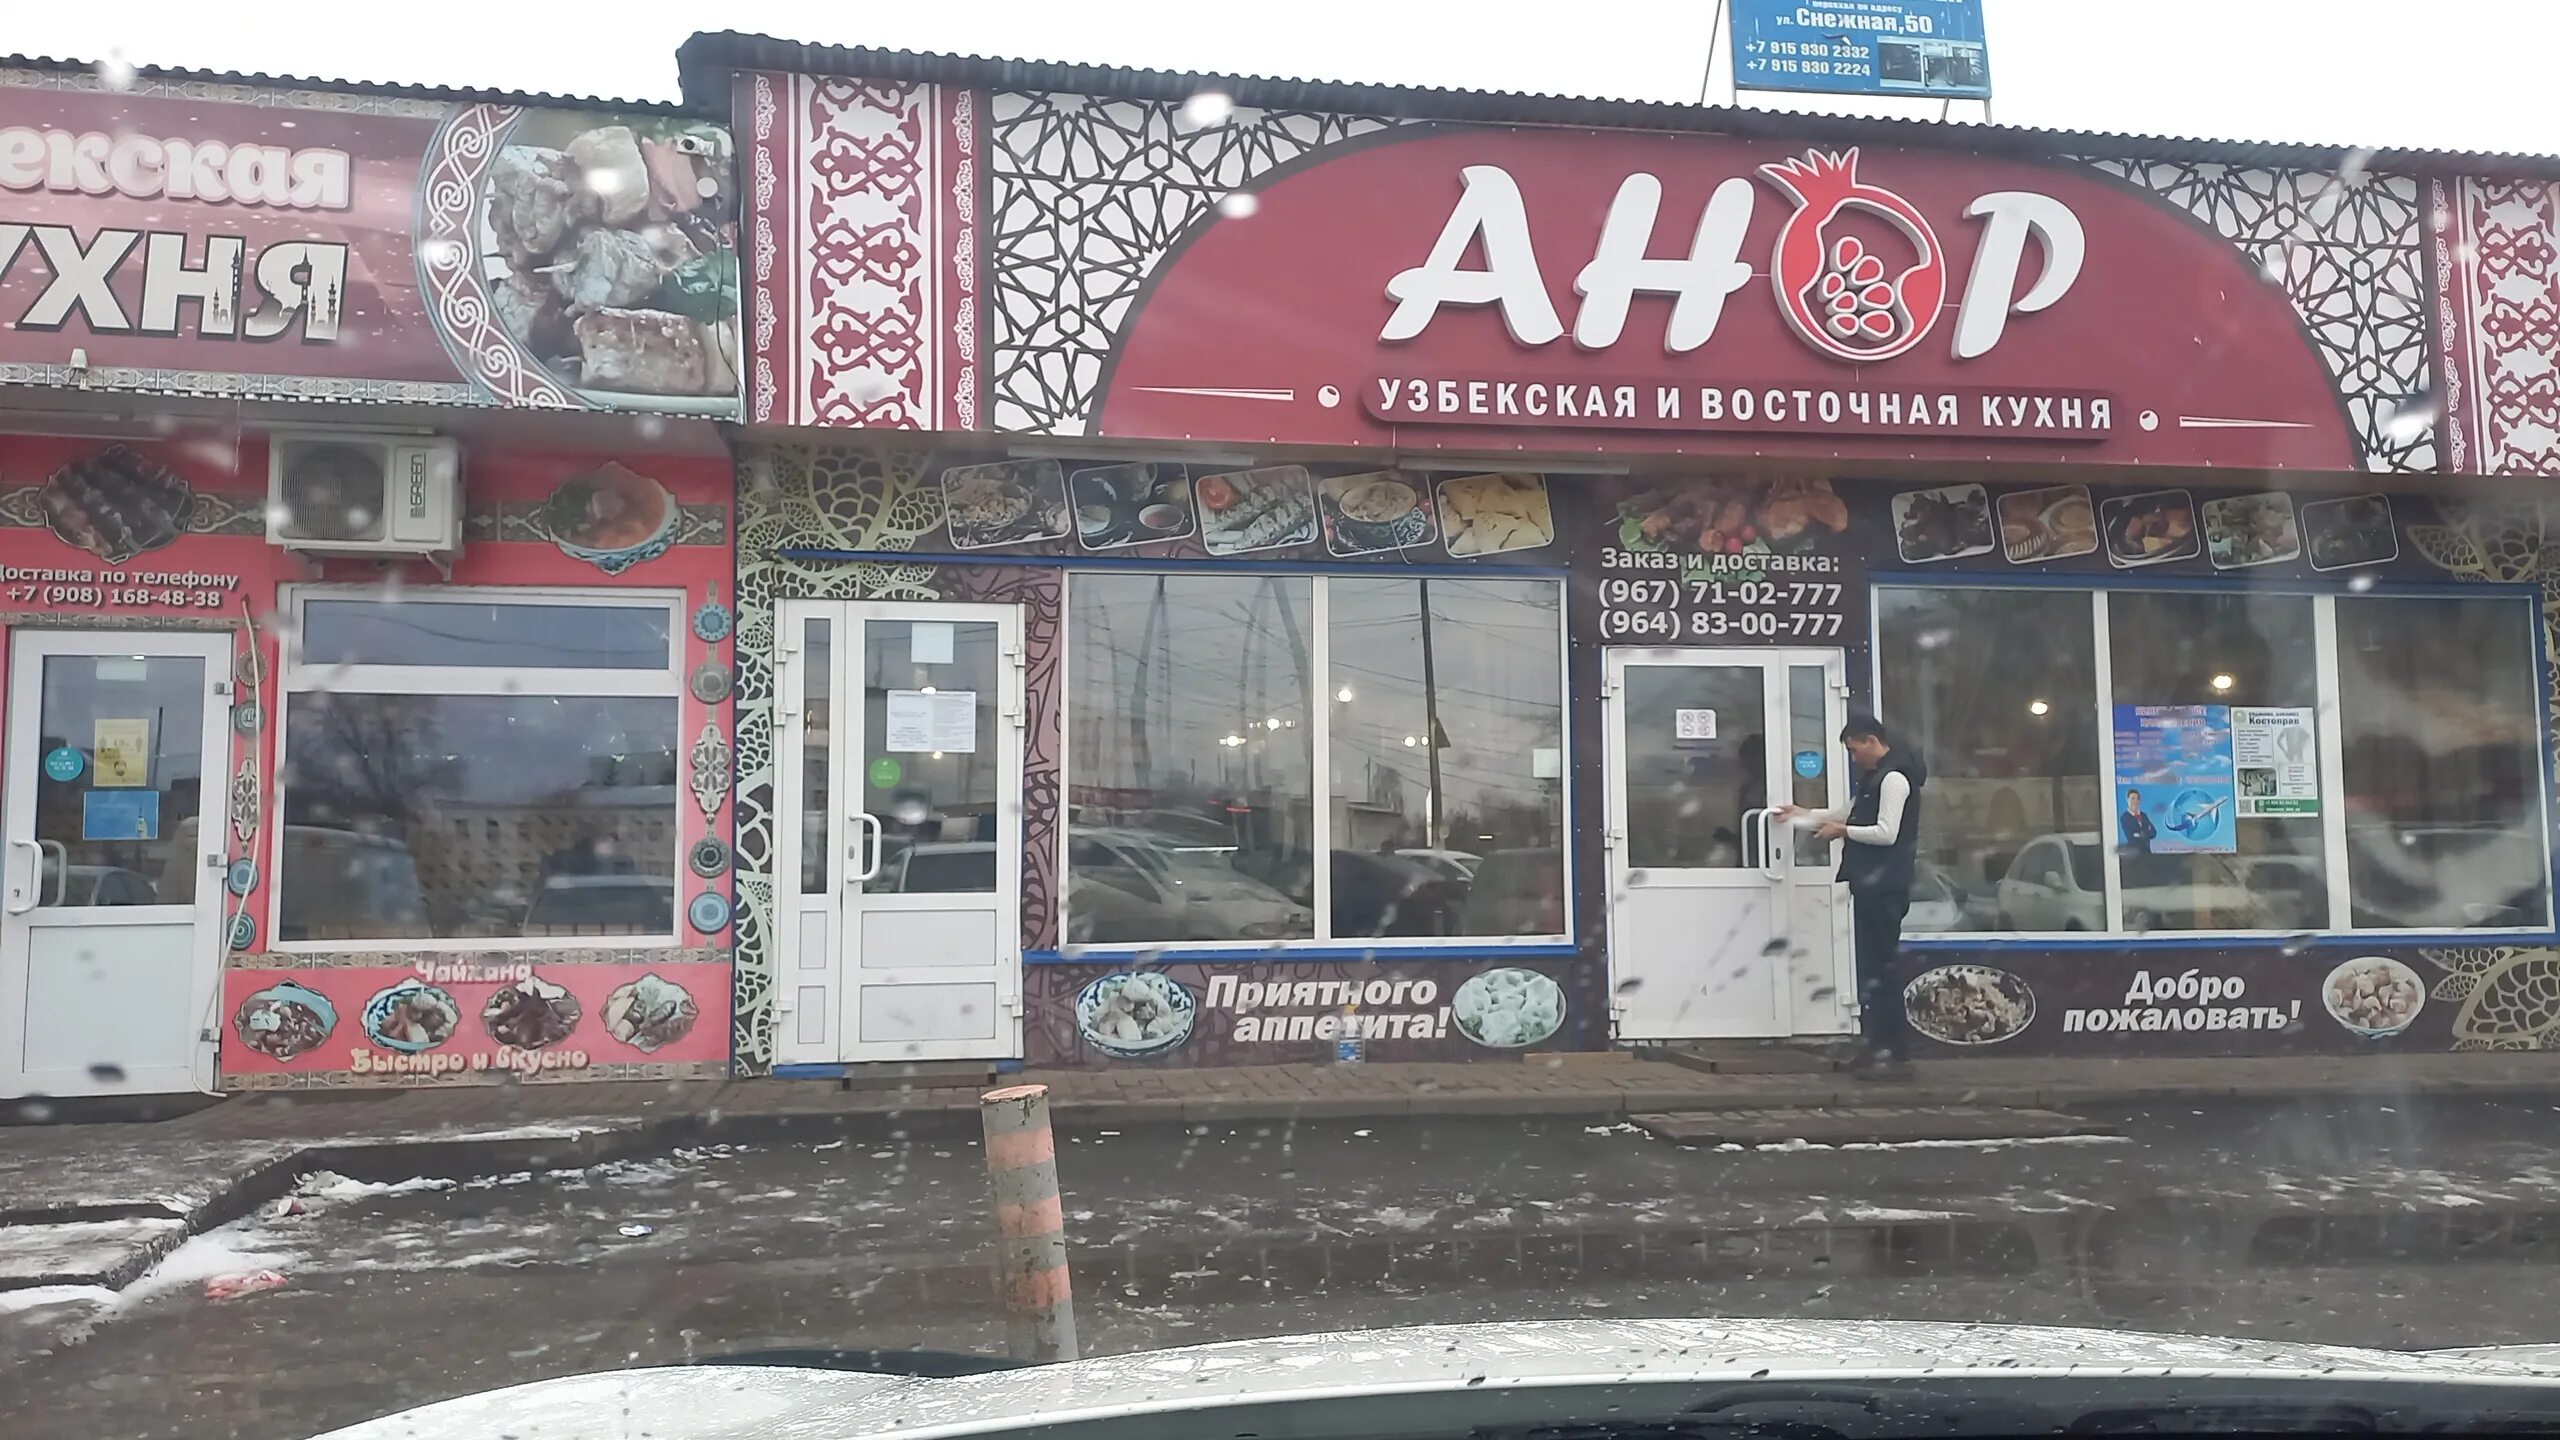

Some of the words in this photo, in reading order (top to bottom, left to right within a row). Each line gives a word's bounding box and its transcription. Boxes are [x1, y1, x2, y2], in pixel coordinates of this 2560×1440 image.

[1776, 14, 1794, 26] ул.
[1796, 7, 1933, 34] Снежная,50
[1745, 40, 1765, 54] +7
[1770, 41, 1797, 55] 915
[1801, 42, 1828, 57] 930
[1746, 57, 1767, 71] +7
[1771, 59, 1798, 72] 915
[1801, 60, 1829, 74] 930
[1833, 61, 1871, 77] 2224
[1377, 378, 1636, 418] УЗБЕКСКАЯ
[1657, 387, 1681, 419] И
[1701, 386, 1959, 426] ВОСТОЧНАЯ
[1981, 395, 2112, 430] КУХНЯ
[1601, 547, 1679, 570] Заказ
[1687, 553, 1703, 570] и
[1711, 552, 1840, 574] доставка:
[100, 569, 126, 584] по
[131, 570, 239, 590] телефону
[1598, 578, 1680, 609] (967)
[1690, 581, 1843, 606] 71-02-777
[6, 585, 37, 602] +7
[43, 586, 102, 607] (908)
[110, 588, 221, 607] 168-48-38
[1598, 608, 1682, 639] (964)
[1691, 611, 1844, 636] 83-00-777
[415, 957, 532, 983] Чайхана
[1205, 974, 1438, 1015] Приятного
[2124, 968, 2246, 1006] Добро
[1232, 1006, 1452, 1042] аппетита!
[2063, 999, 2302, 1033] пожаловать!
[350, 1047, 468, 1077] Быстро
[472, 1052, 490, 1070] и
[496, 1046, 589, 1075] вкусно
